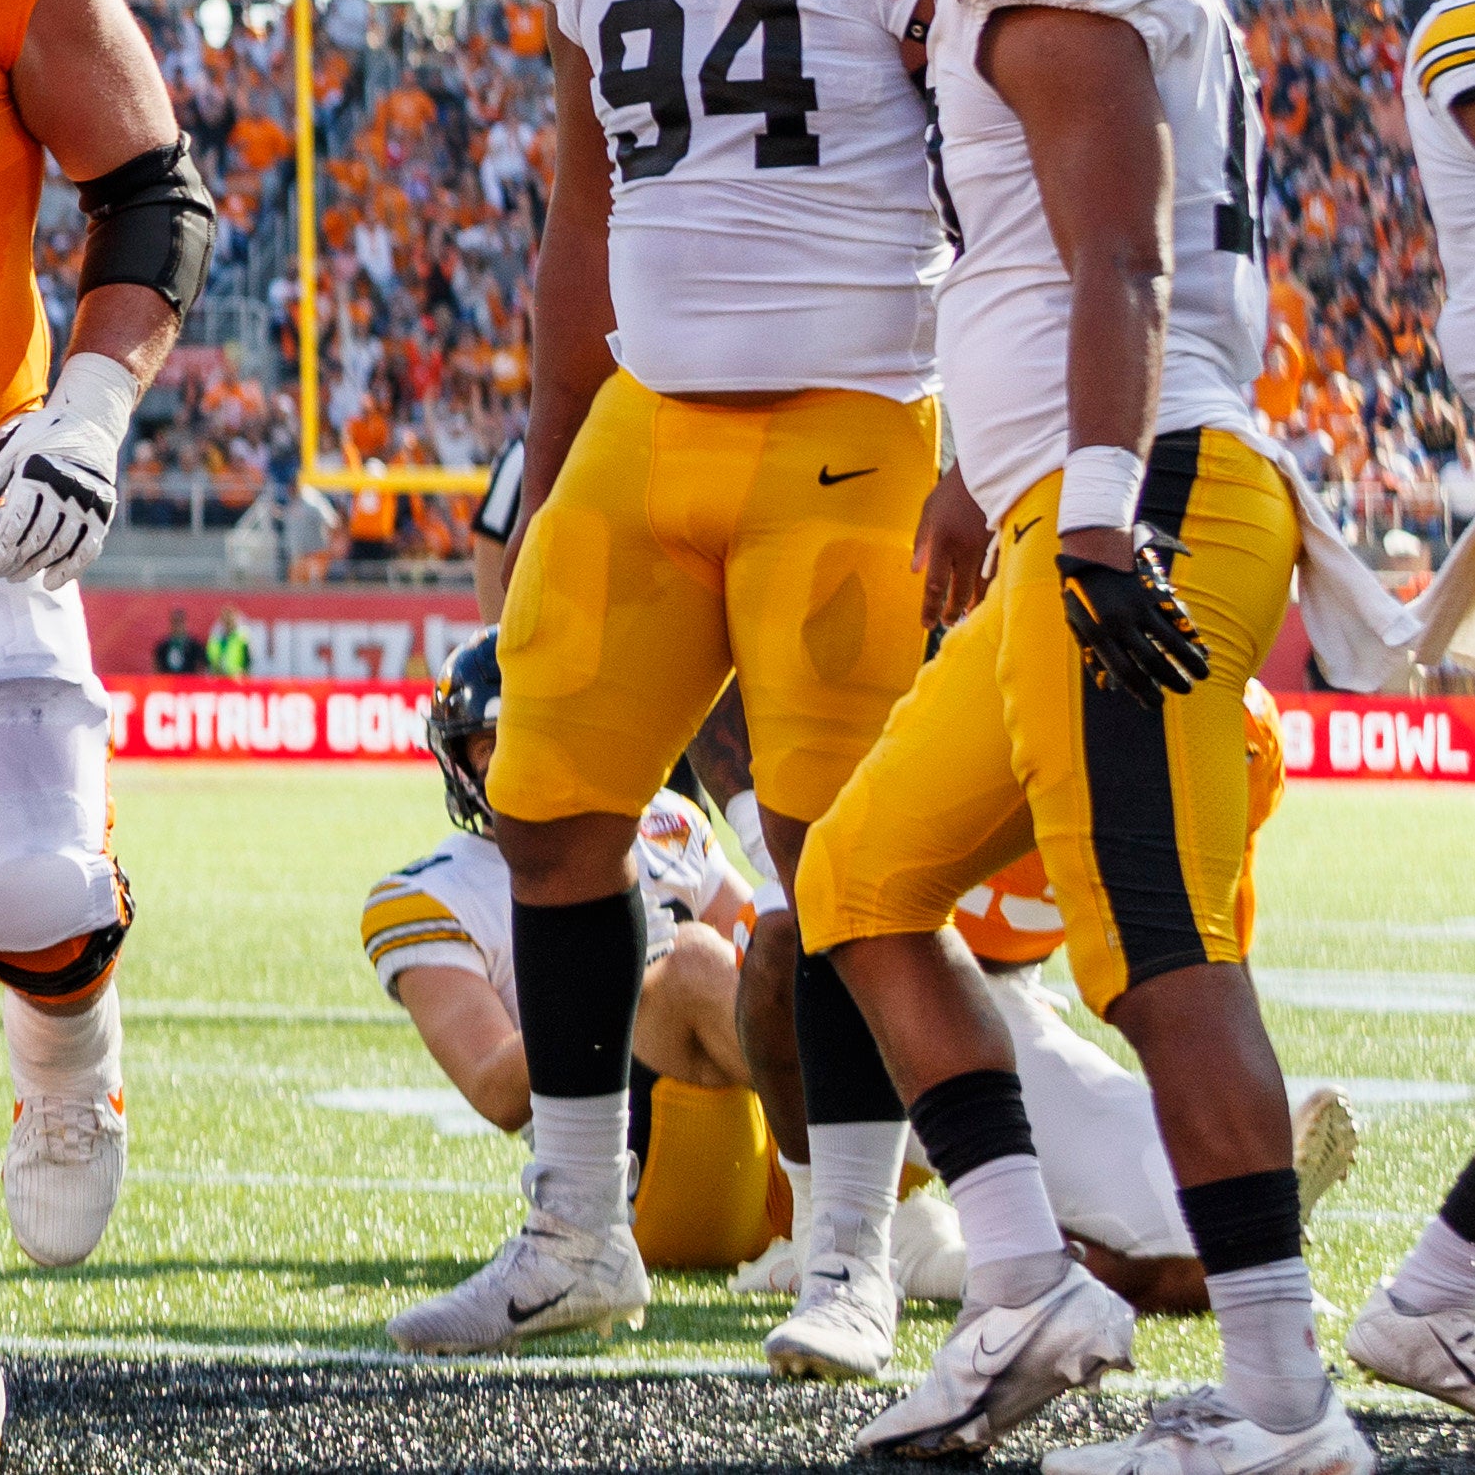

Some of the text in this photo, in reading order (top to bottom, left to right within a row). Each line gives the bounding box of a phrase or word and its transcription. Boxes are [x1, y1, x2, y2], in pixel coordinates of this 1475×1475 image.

[143, 690, 318, 754] CITRUS
[326, 692, 432, 754] BOW
[1329, 709, 1471, 774] BOWL
